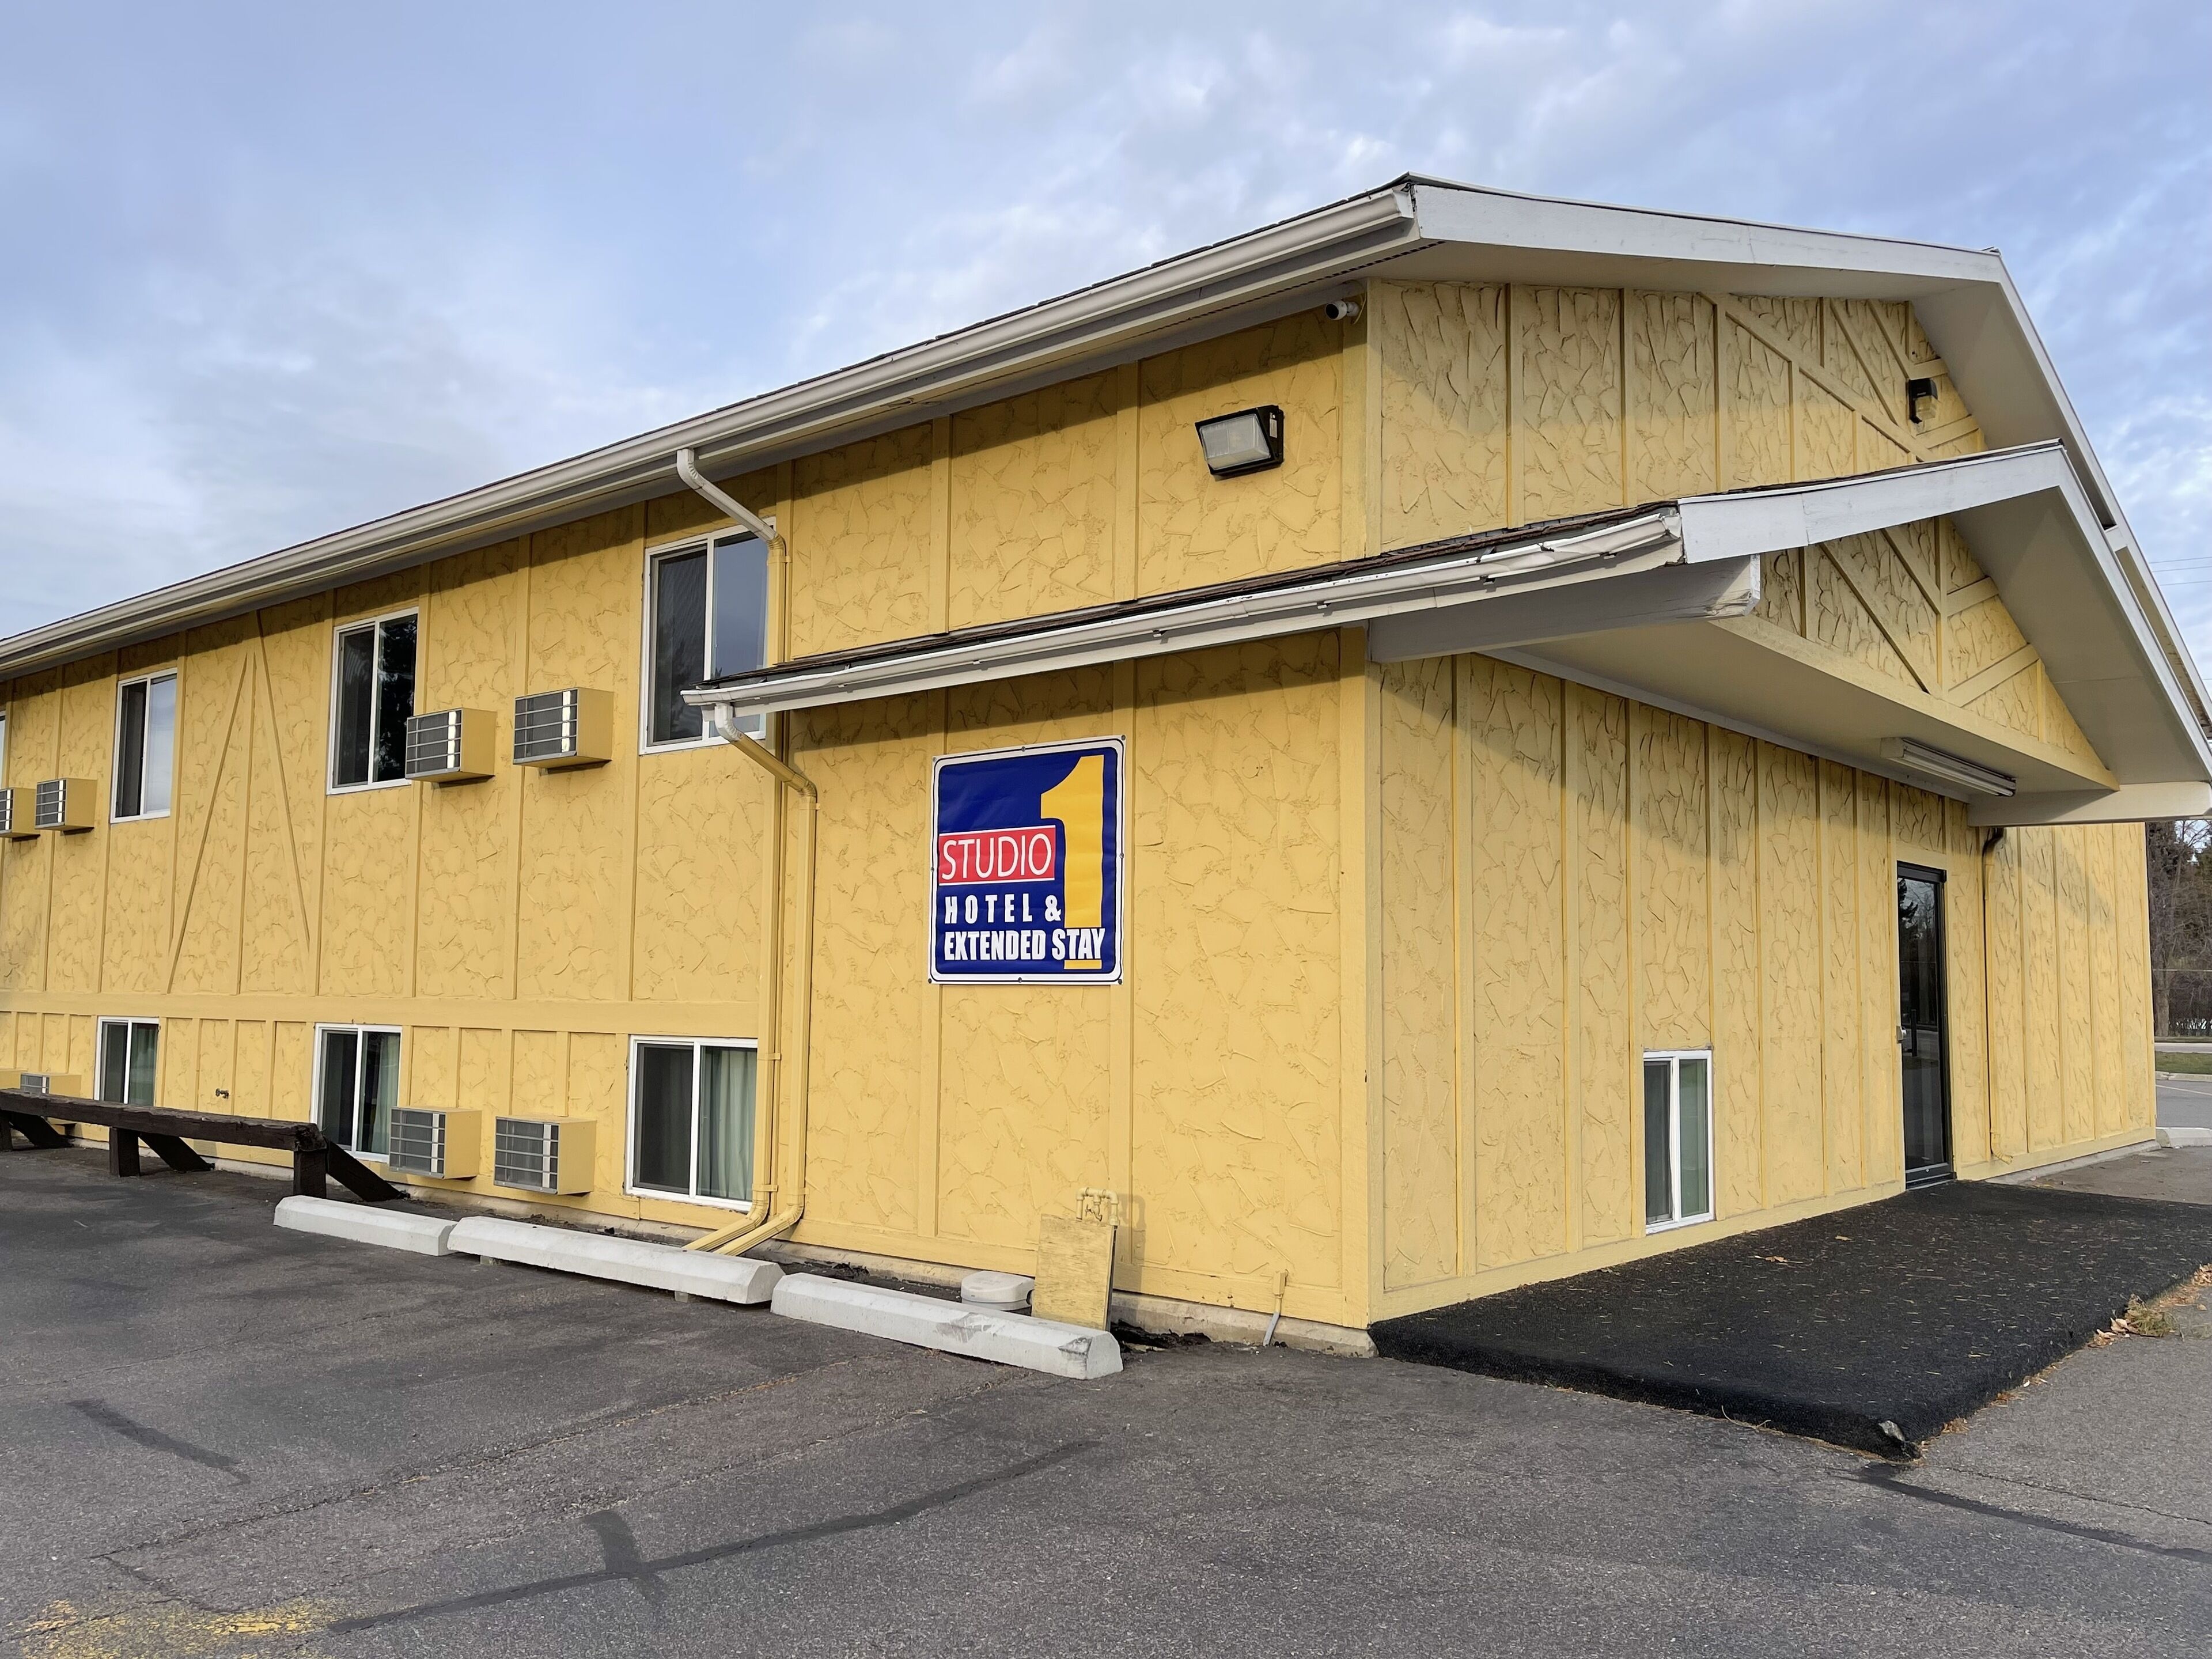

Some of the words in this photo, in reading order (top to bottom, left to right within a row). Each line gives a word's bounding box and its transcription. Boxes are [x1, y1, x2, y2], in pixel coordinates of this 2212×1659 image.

[941, 833, 1052, 881] STUDIO
[1041, 754, 1104, 969] 1
[945, 893, 1032, 924] HOTEL
[1044, 895, 1061, 922] &
[944, 929, 1046, 960] EXTENDED
[1052, 928, 1105, 960] STAY
